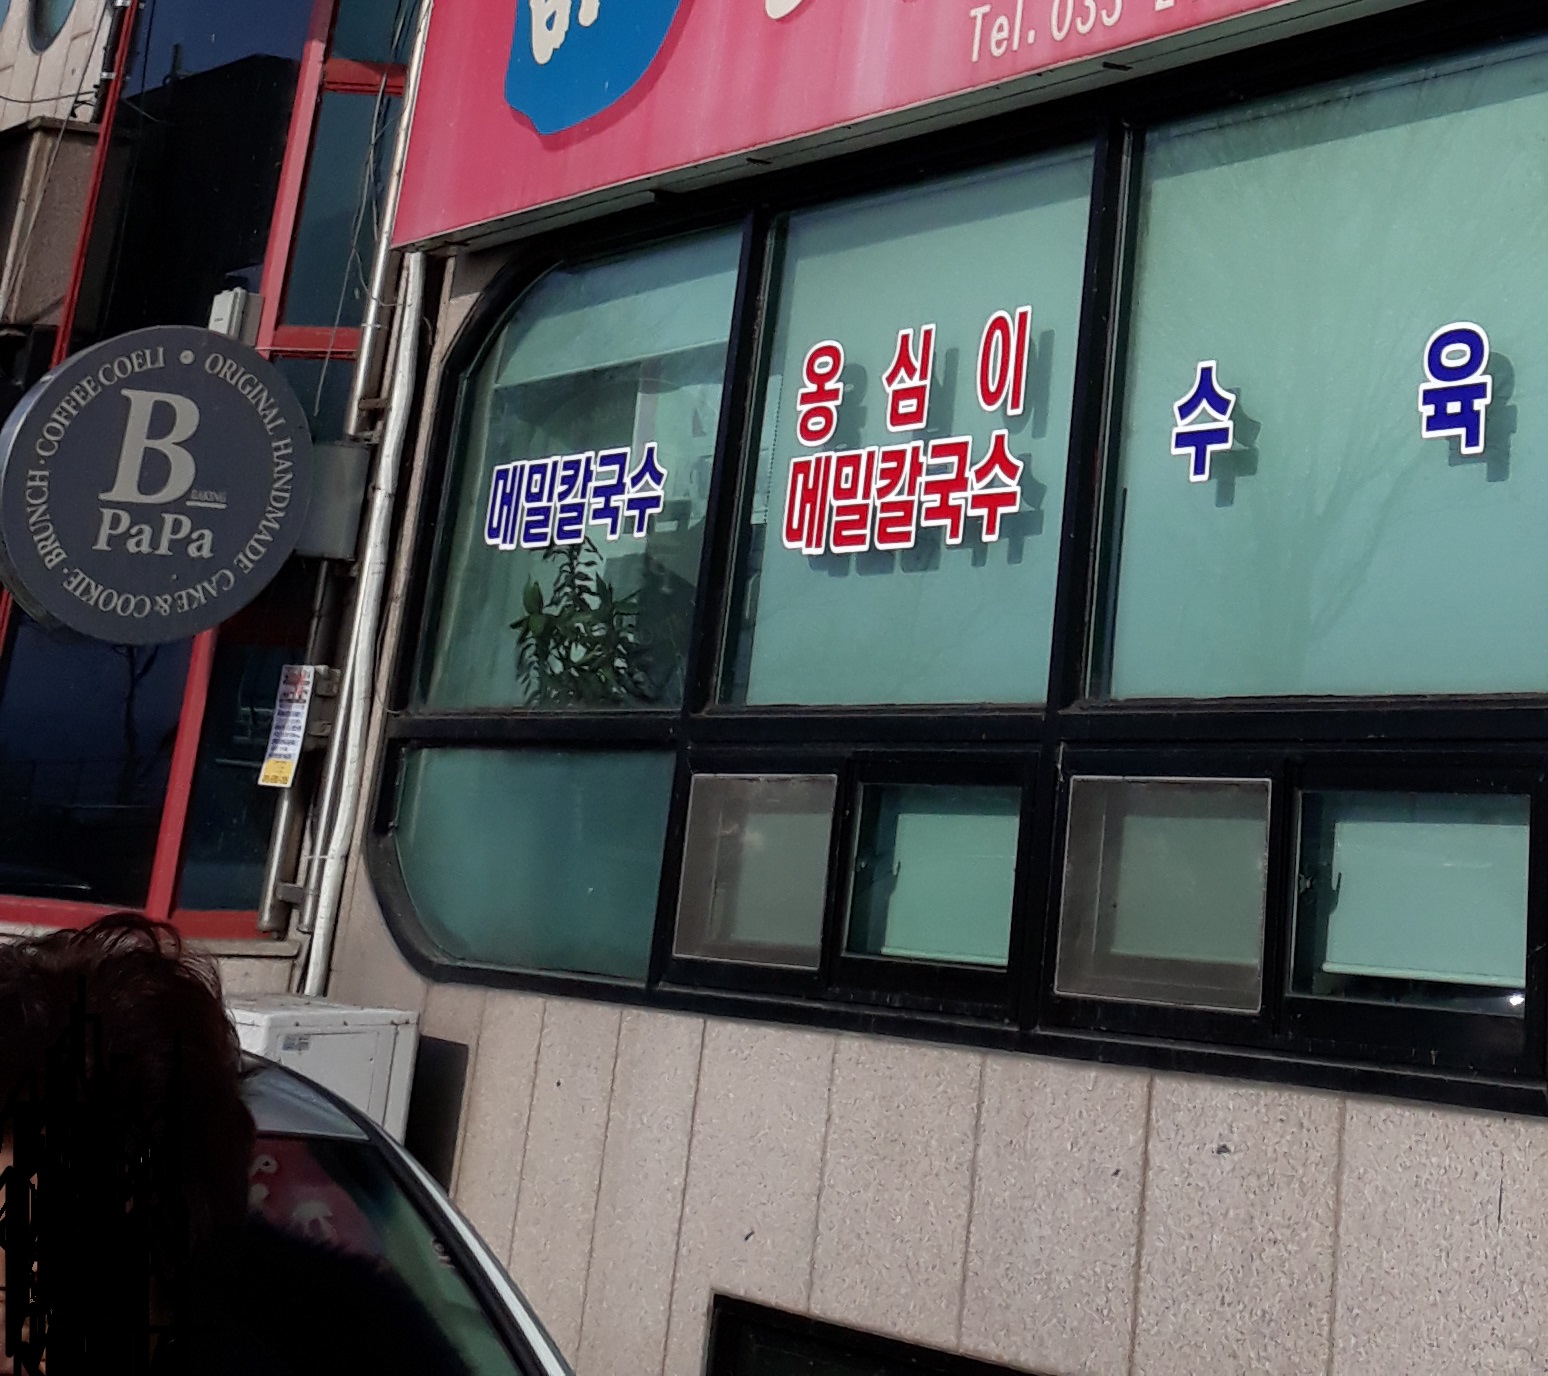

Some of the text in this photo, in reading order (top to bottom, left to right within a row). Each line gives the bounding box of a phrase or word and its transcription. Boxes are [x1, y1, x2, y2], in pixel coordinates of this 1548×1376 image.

[36, 376, 103, 458] COFFEE
[99, 346, 166, 386] COELI
[204, 353, 286, 436] ORIGINAL
[796, 305, 1034, 447] 옹심이
[26, 469, 68, 571] BRUNCH
[92, 507, 215, 560] PaPa
[234, 437, 294, 575] HANDMADE
[484, 442, 667, 550] 메밀칼국수
[782, 429, 1023, 555] 메밀칼국수
